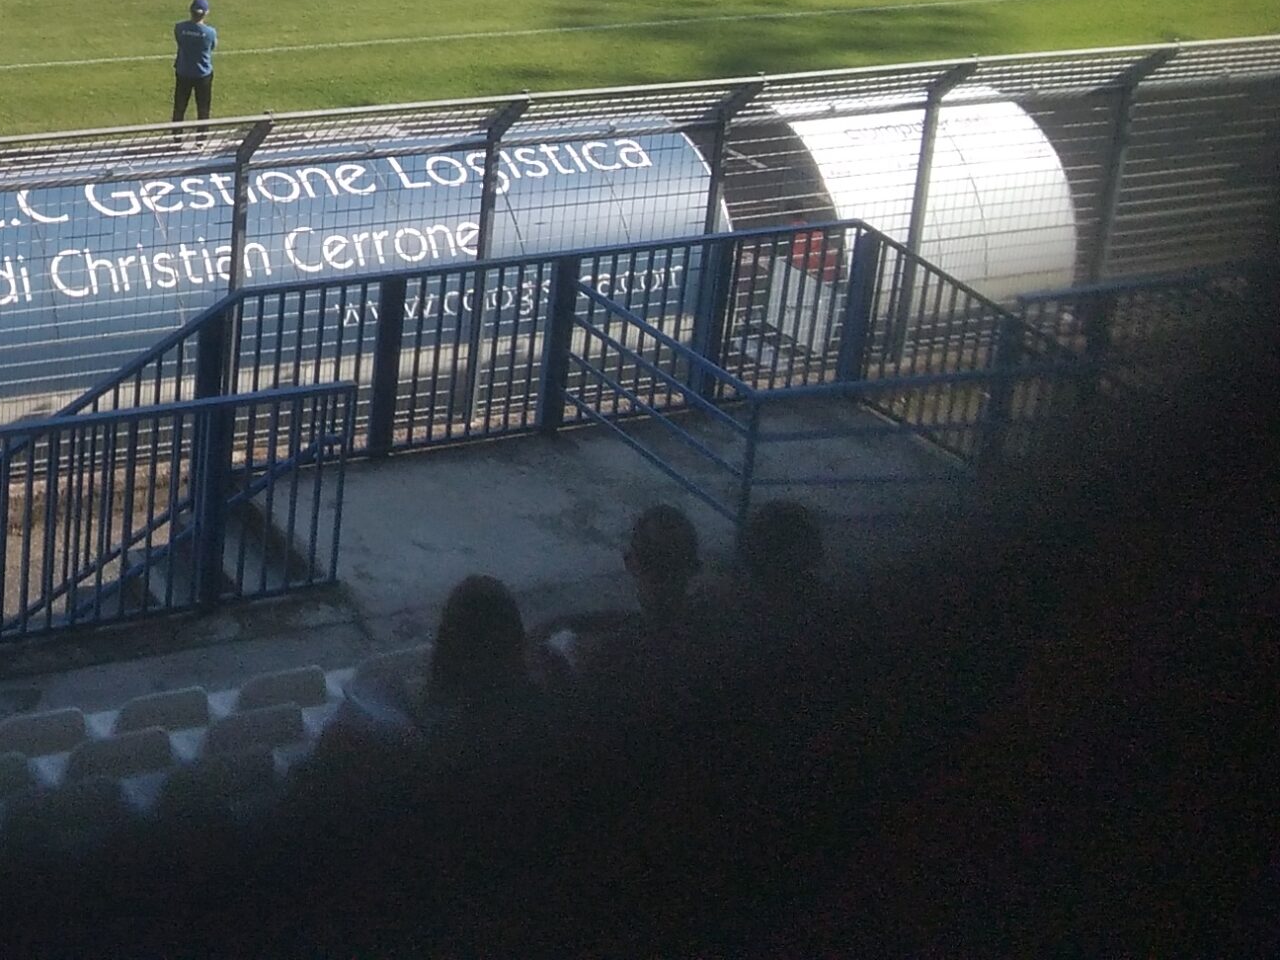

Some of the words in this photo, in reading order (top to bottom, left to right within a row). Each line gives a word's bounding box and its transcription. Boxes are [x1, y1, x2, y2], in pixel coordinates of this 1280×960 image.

[84, 163, 377, 218] Gestione
[386, 138, 653, 195] Logistica
[50, 236, 273, 298] Christian
[284, 222, 480, 273] Cerrone
